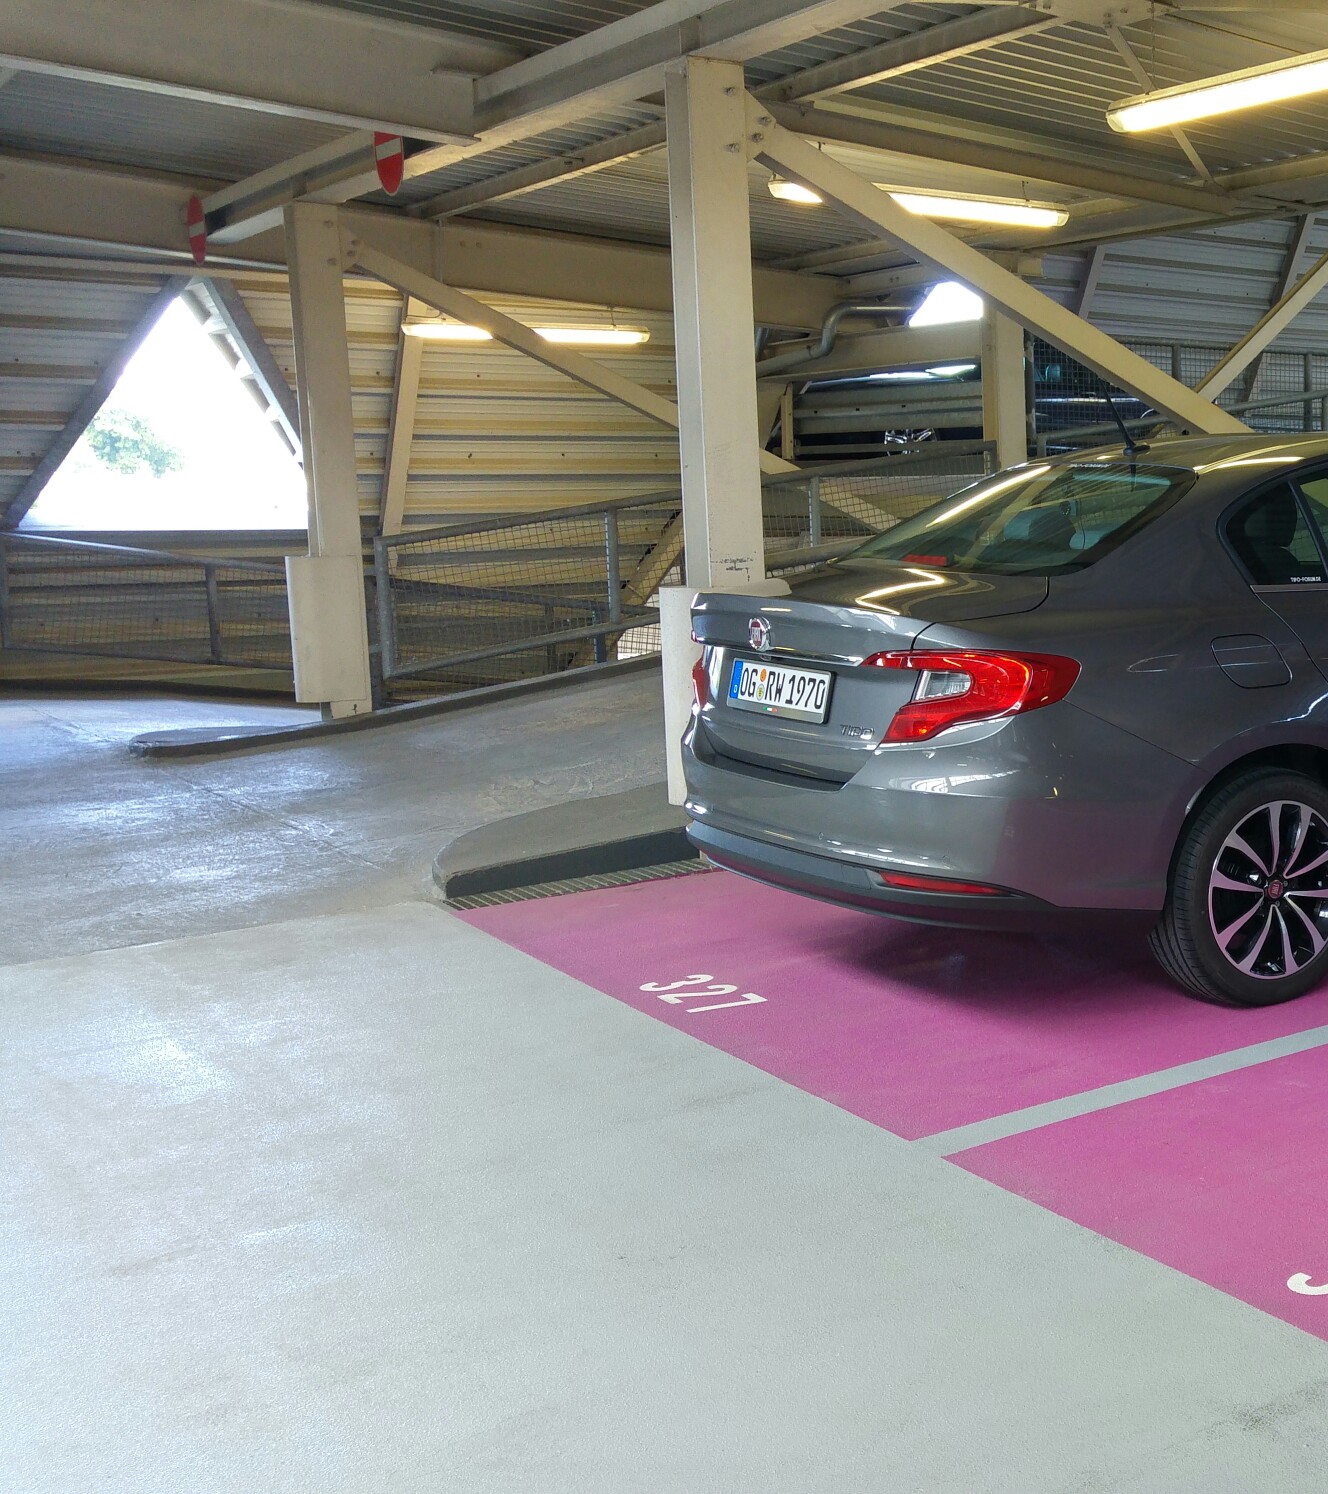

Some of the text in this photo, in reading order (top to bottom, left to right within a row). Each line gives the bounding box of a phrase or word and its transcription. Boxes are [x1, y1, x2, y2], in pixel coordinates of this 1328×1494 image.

[740, 667, 826, 710] OG RW 1970
[639, 974, 769, 1013] 327
